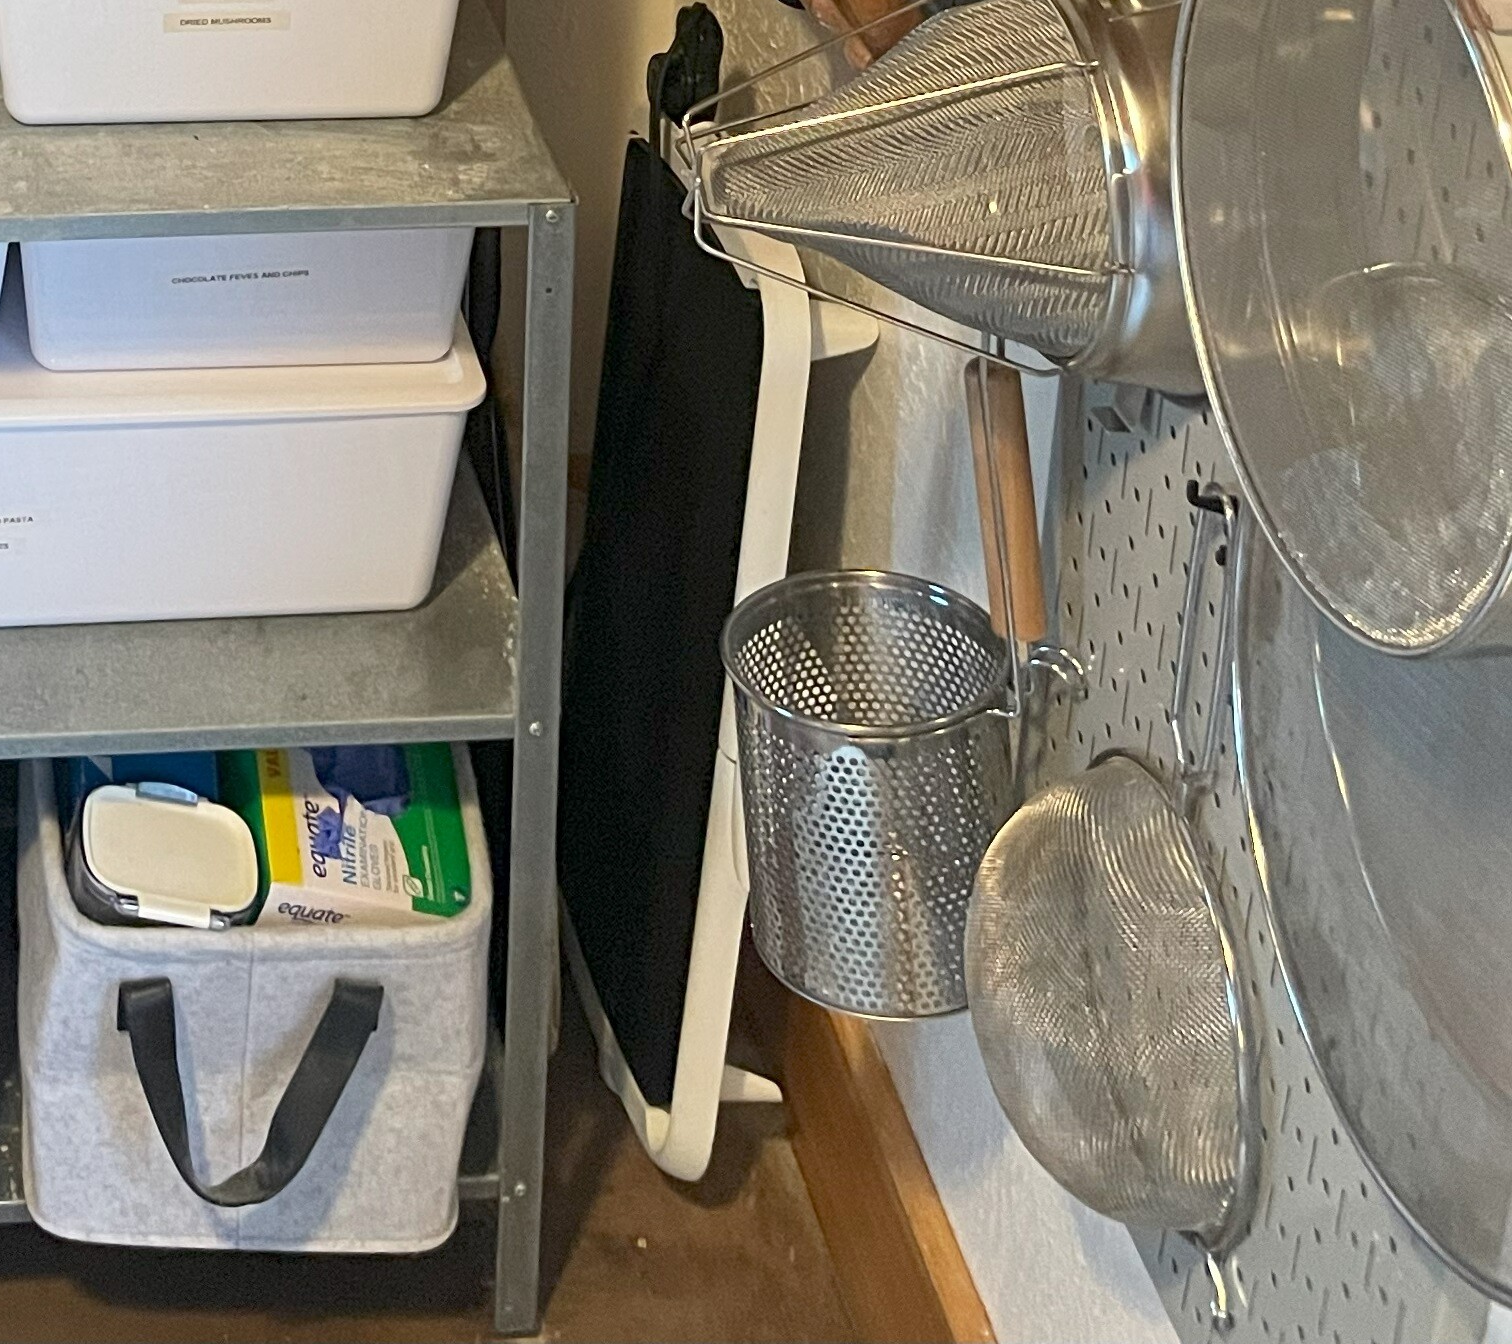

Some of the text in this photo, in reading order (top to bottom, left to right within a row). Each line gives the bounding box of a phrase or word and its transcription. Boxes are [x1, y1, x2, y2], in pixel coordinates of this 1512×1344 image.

[180, 17, 272, 26] DRIED MUSHROOMS
[171, 269, 310, 284] CHOCOLATE FEVES AND CHIPS
[3, 516, 34, 524] PASTA
[341, 824, 358, 885] Nitrile
[368, 843, 382, 891] GLOVES
[277, 901, 345, 924] equate
